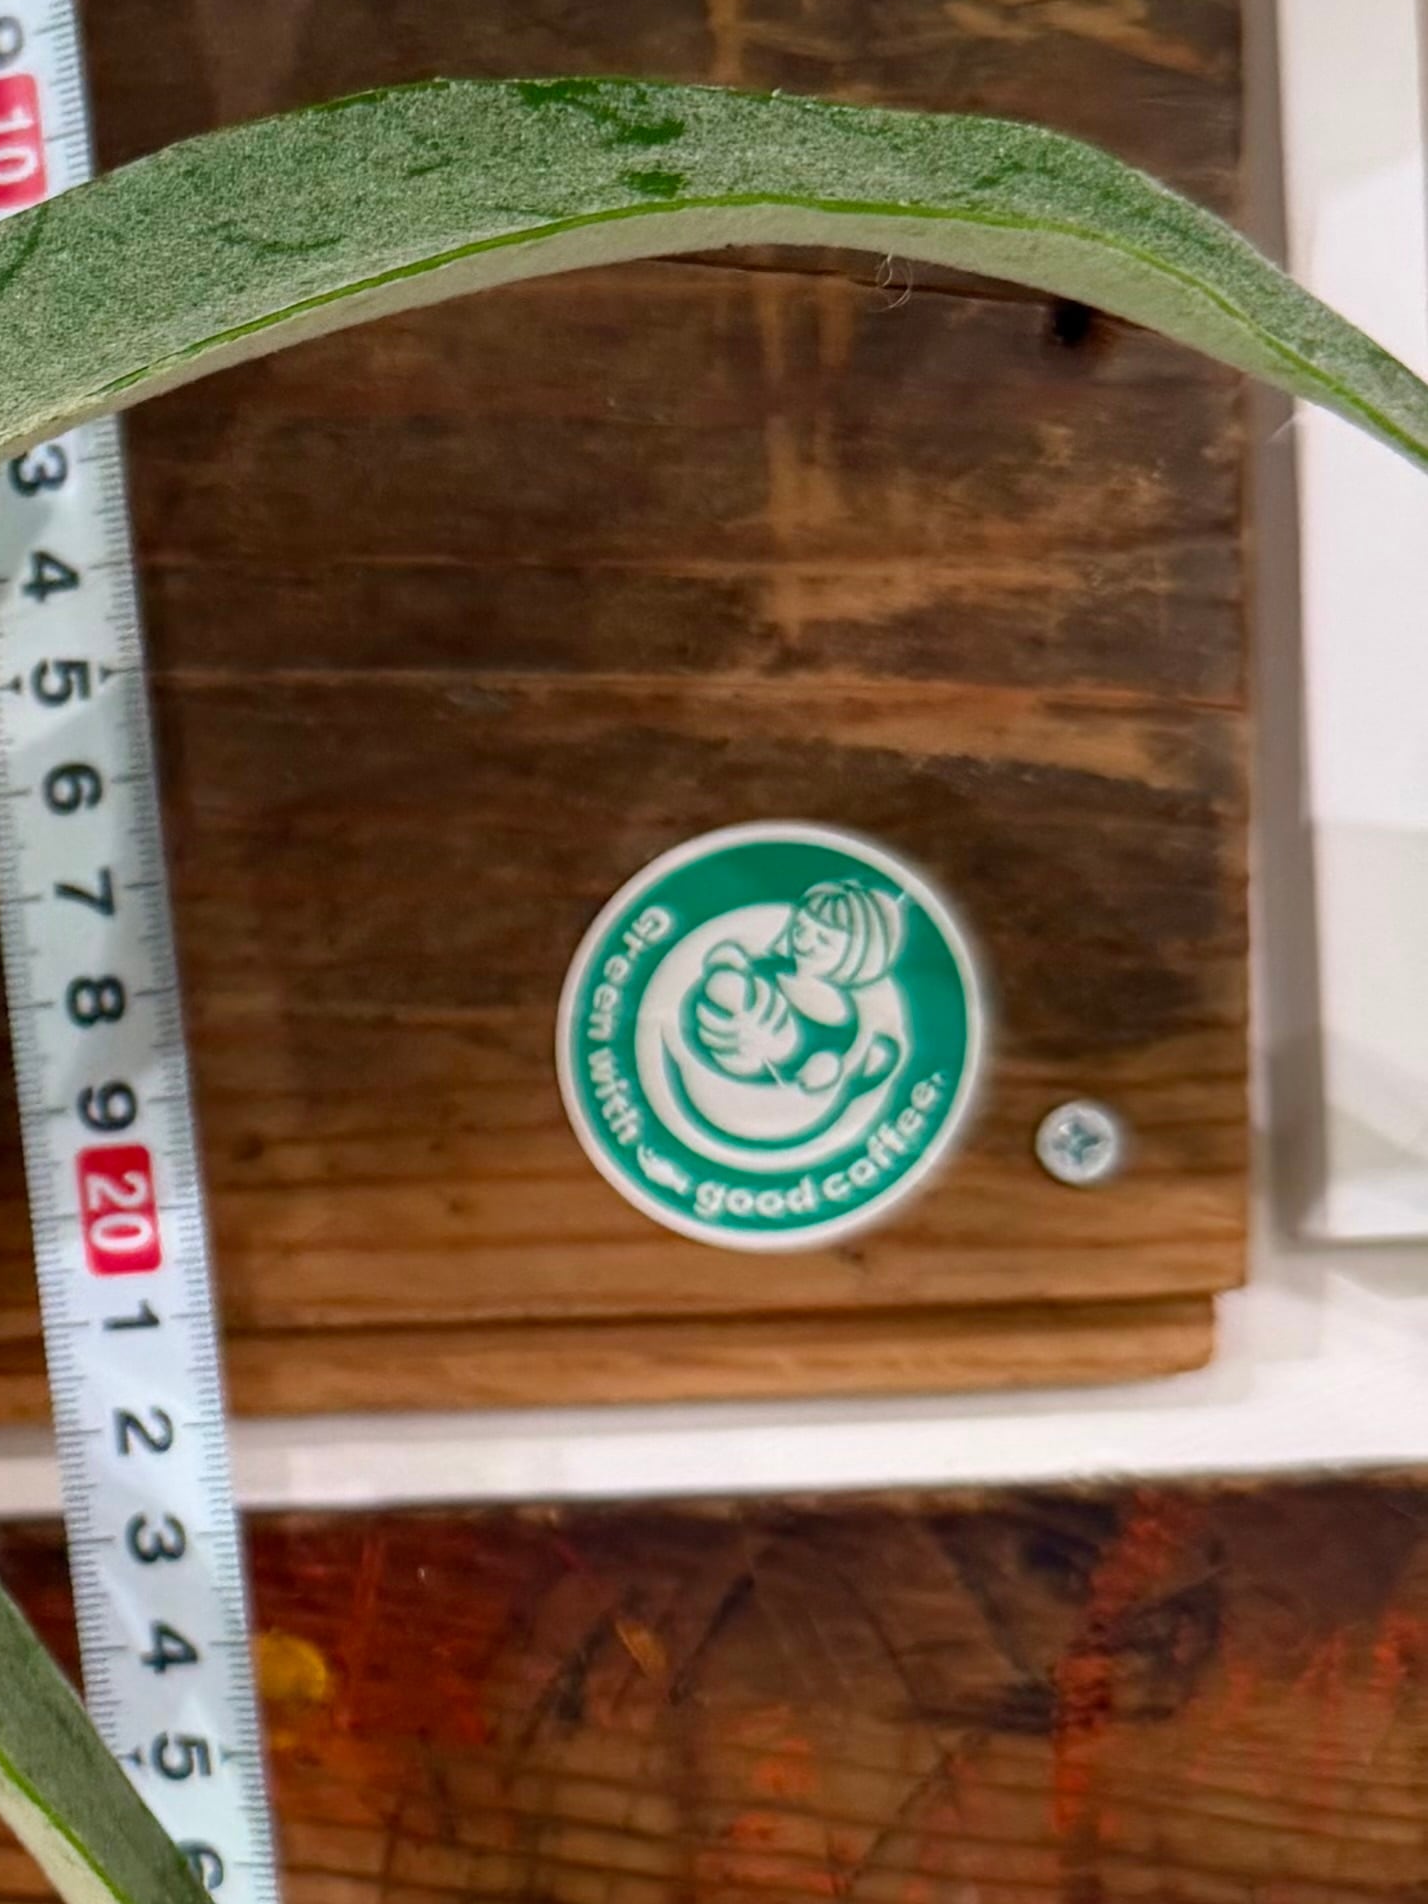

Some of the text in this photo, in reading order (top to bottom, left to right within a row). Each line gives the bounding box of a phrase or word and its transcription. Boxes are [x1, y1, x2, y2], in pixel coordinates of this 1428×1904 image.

[20, 552, 80, 604] 4
[30, 658, 91, 708] 5
[43, 763, 103, 814] 6
[52, 867, 116, 918] 7
[586, 906, 672, 1042] Green
[65, 976, 126, 1027] 8
[77, 1080, 137, 1132] 9
[588, 1047, 644, 1146] with
[84, 1169, 154, 1251] 20
[693, 1175, 817, 1218] good
[102, 1299, 160, 1332] 1
[113, 1407, 174, 1456] 2
[126, 1514, 186, 1565] 3
[140, 1621, 200, 1675] 4
[152, 1731, 212, 1782] 5
